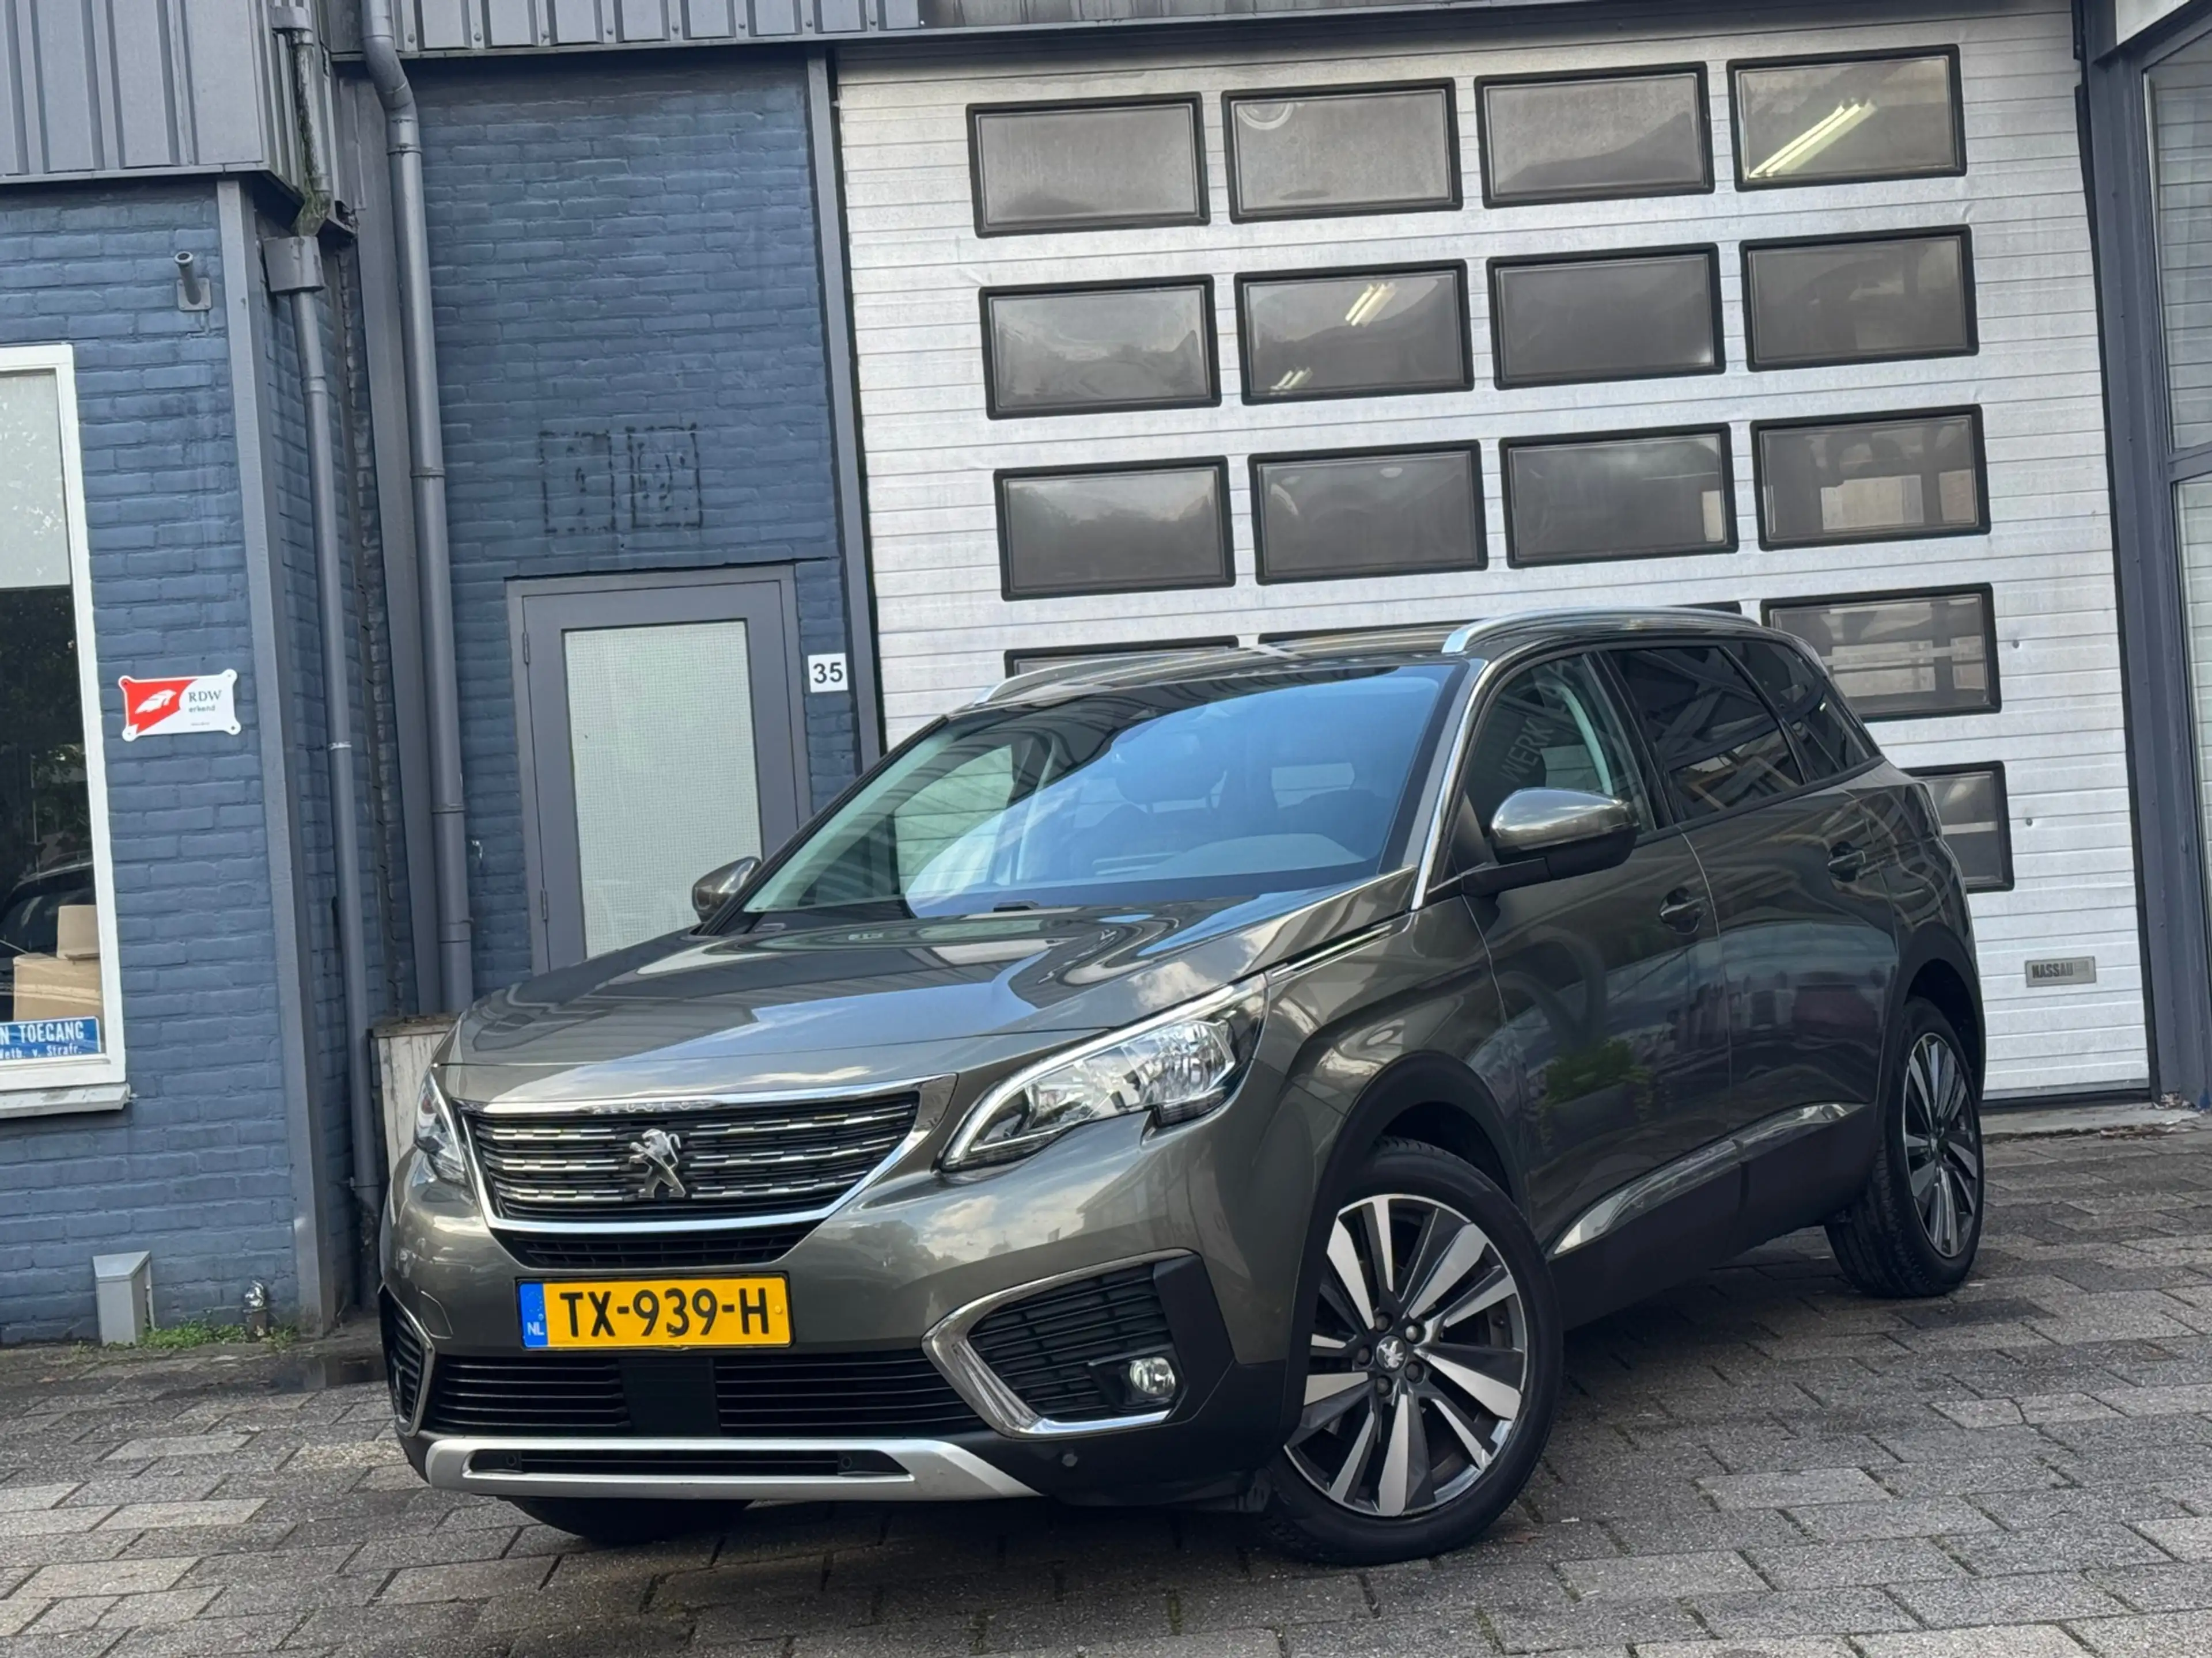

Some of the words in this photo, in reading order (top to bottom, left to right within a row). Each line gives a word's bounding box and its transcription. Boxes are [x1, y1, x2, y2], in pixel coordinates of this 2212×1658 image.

[813, 662, 843, 684] 35
[188, 689, 222, 703] RDW
[188, 703, 215, 712] erkend
[2032, 962, 2074, 979] NASSAU
[18, 1020, 84, 1044] TOEGANG
[46, 1042, 82, 1056] Strafr.
[527, 1321, 545, 1336] NL
[559, 1287, 770, 1338] TX-939-H
